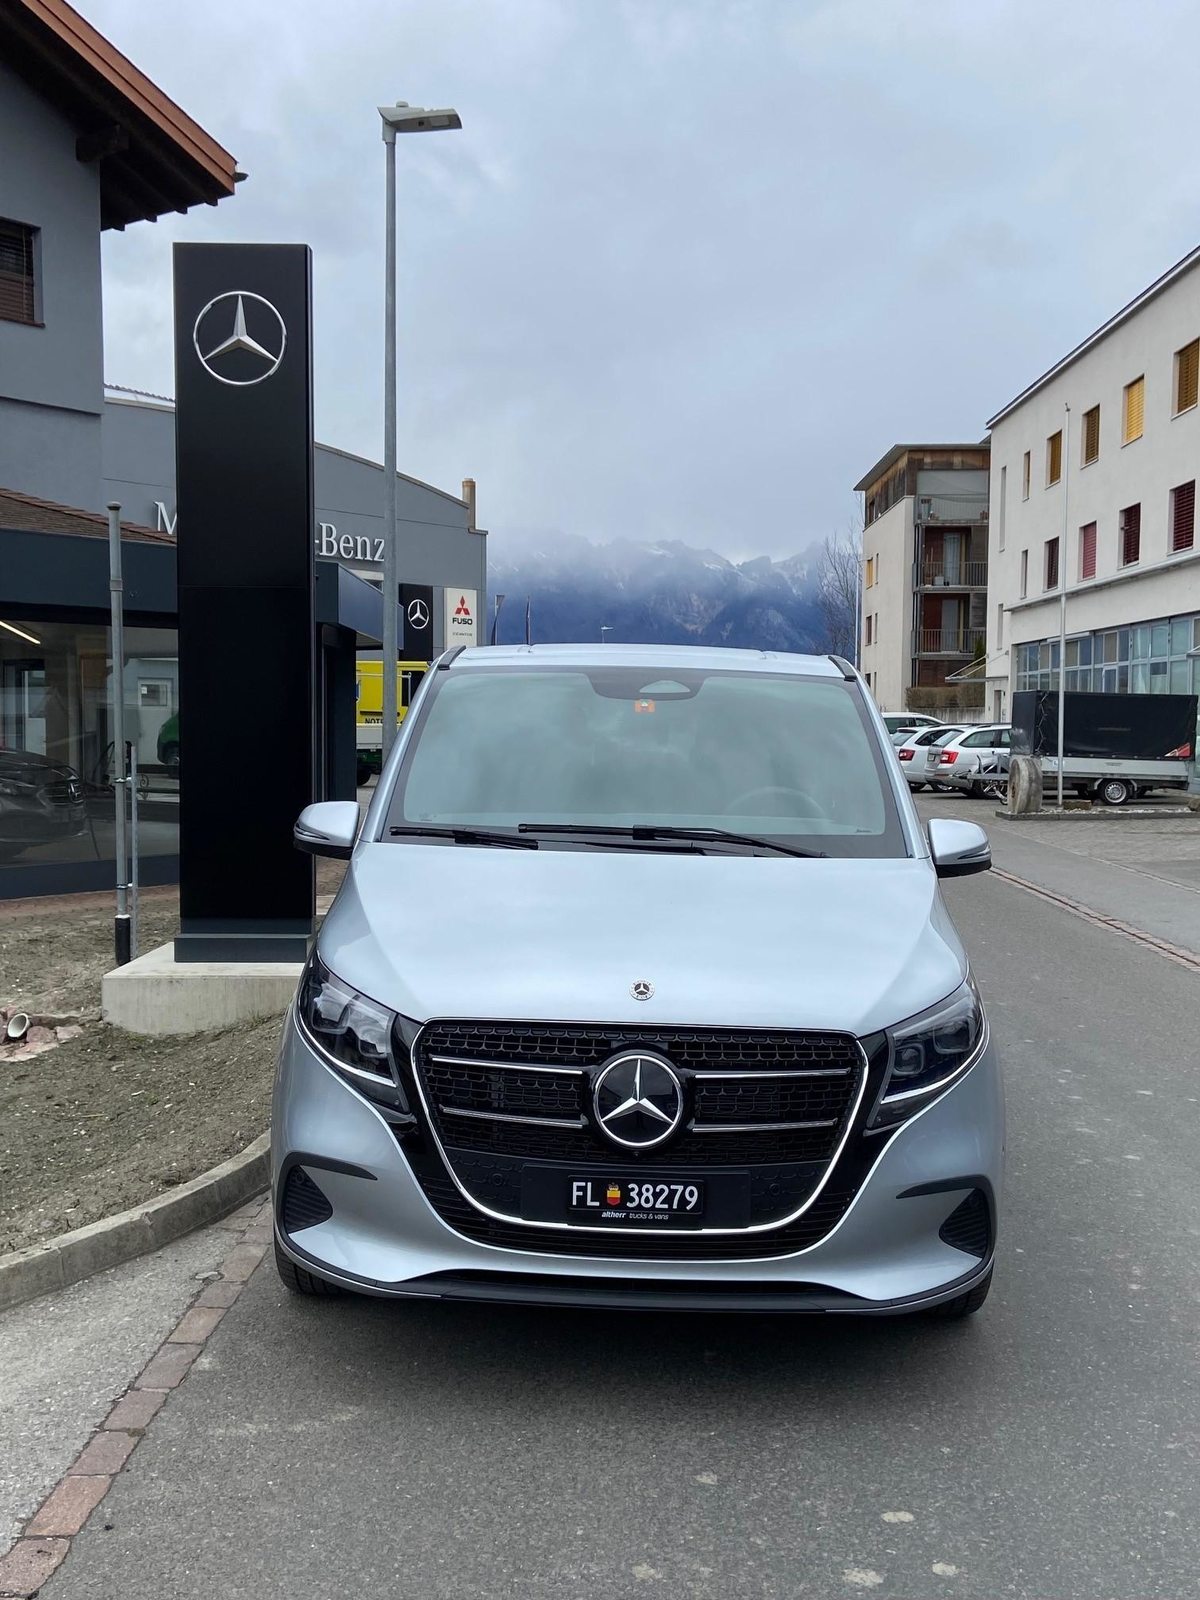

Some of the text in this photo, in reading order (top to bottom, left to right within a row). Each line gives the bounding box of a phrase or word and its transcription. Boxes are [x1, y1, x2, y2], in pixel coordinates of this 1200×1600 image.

[452, 617, 473, 626] FUSO
[572, 1181, 699, 1211] FL 38279
